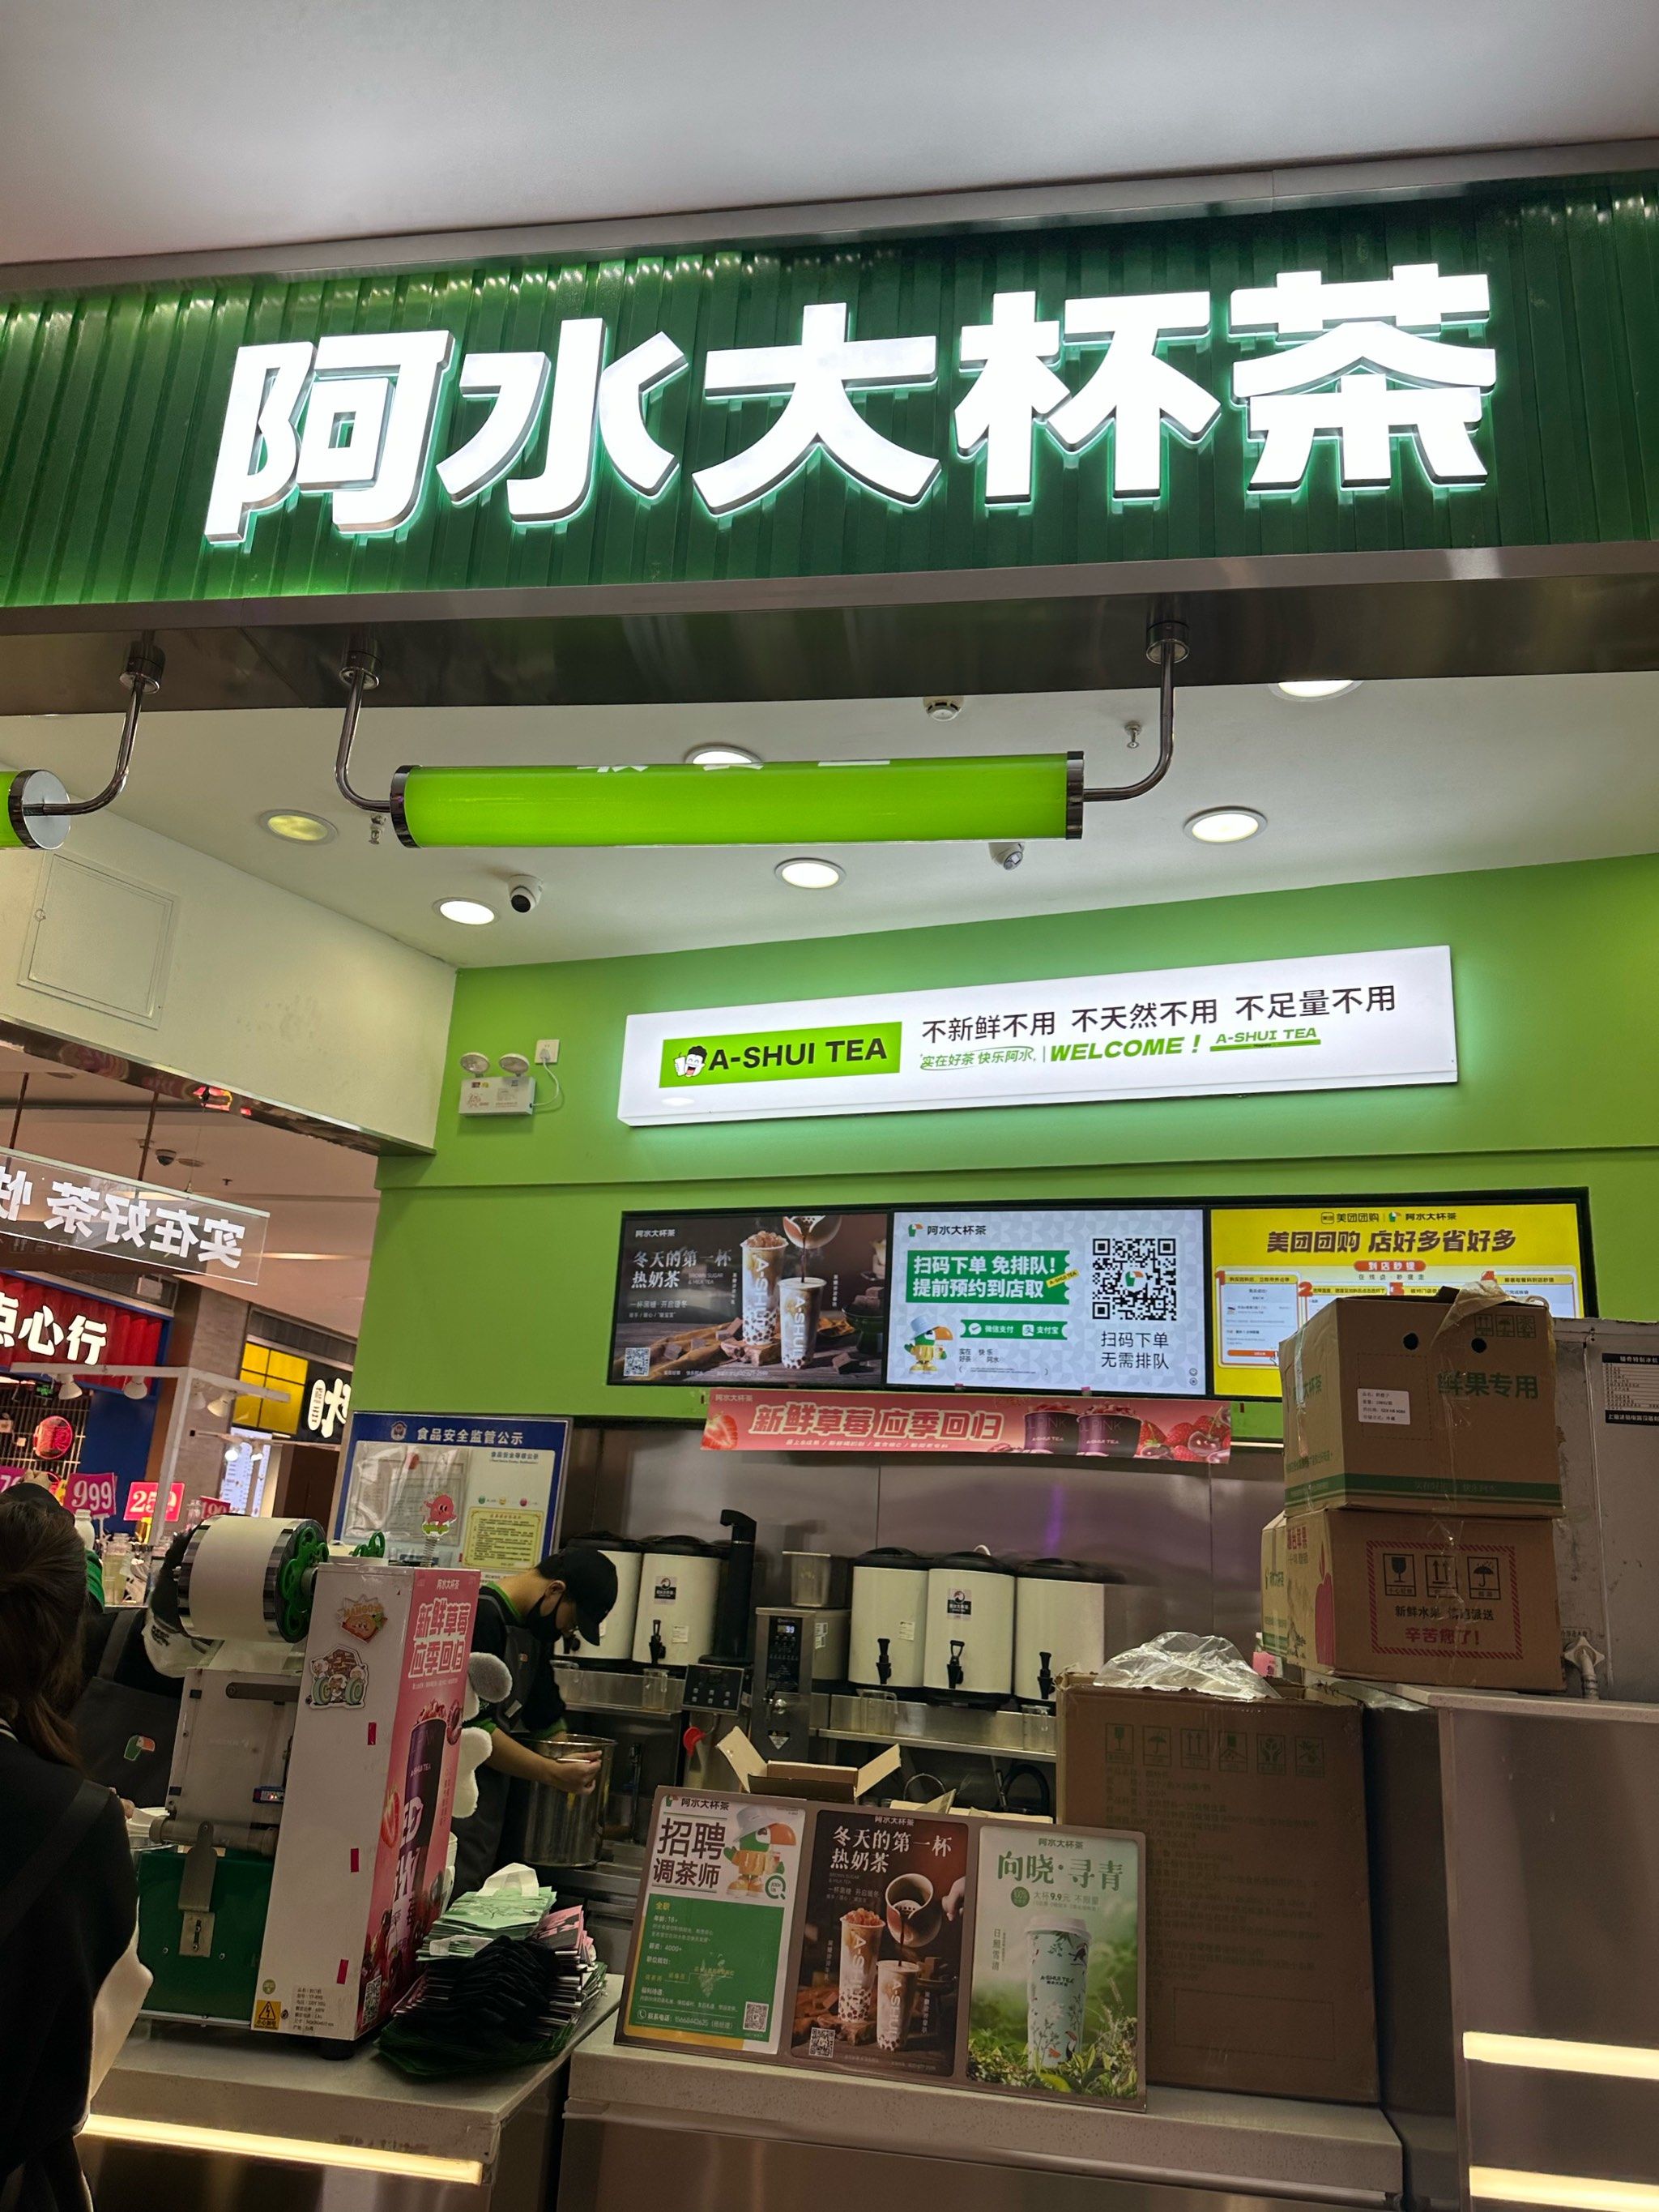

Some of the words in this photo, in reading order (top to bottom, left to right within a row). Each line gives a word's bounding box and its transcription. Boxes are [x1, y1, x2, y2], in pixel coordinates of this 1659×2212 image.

[204, 262, 1499, 548] 阿水大杯茶
[922, 1011, 1056, 1044] 不新鲜不用
[1072, 998, 1218, 1032] 不天然不用
[1235, 985, 1396, 1022] 不足量不用
[1215, 1029, 1277, 1044] A-SHUI
[1283, 1027, 1317, 1040] TEA
[708, 1043, 815, 1071] A-SHUI
[825, 1038, 887, 1062] TEA
[1337, 1213, 1379, 1223] 美团团购
[1405, 1212, 1456, 1221] 阿水大杯茶
[635, 1229, 676, 1238] 阿水大杯茶
[927, 1225, 987, 1236] 阿水大杯茶
[1267, 1231, 1360, 1253] 美团团购
[1368, 1229, 1516, 1253] 店好多省好多
[633, 1248, 732, 1269] 冬天的第一杯
[914, 1256, 987, 1275] 扫码下单
[1368, 1261, 1416, 1271] 到店秒提
[631, 1270, 681, 1288] 热奶茶
[913, 1279, 1044, 1298] 提前预约到店取
[1037, 1325, 1060, 1334] 支付宝
[1101, 1331, 1169, 1348] 扫码下单
[1101, 1352, 1170, 1369] 无需排队
[1438, 1370, 1538, 1399] 鲜果专用
[715, 1394, 753, 1403] 阿水大杯茶
[416, 1426, 524, 1445] 食品安全监管公示
[72, 1480, 113, 1510] 999
[413, 1597, 471, 1641] 新鲜草莓
[408, 1639, 465, 1679] 应季回归
[680, 1797, 730, 1811] 阿水大杯茶
[875, 1816, 915, 1826] 阿水大杯茶
[656, 1817, 726, 1860] 招聘
[833, 1826, 953, 1858] 冬天的第一杯
[1038, 1838, 1084, 1851] 阿水大杯茶
[830, 1848, 889, 1873] 热奶茶
[652, 1858, 722, 1890] 调茶师
